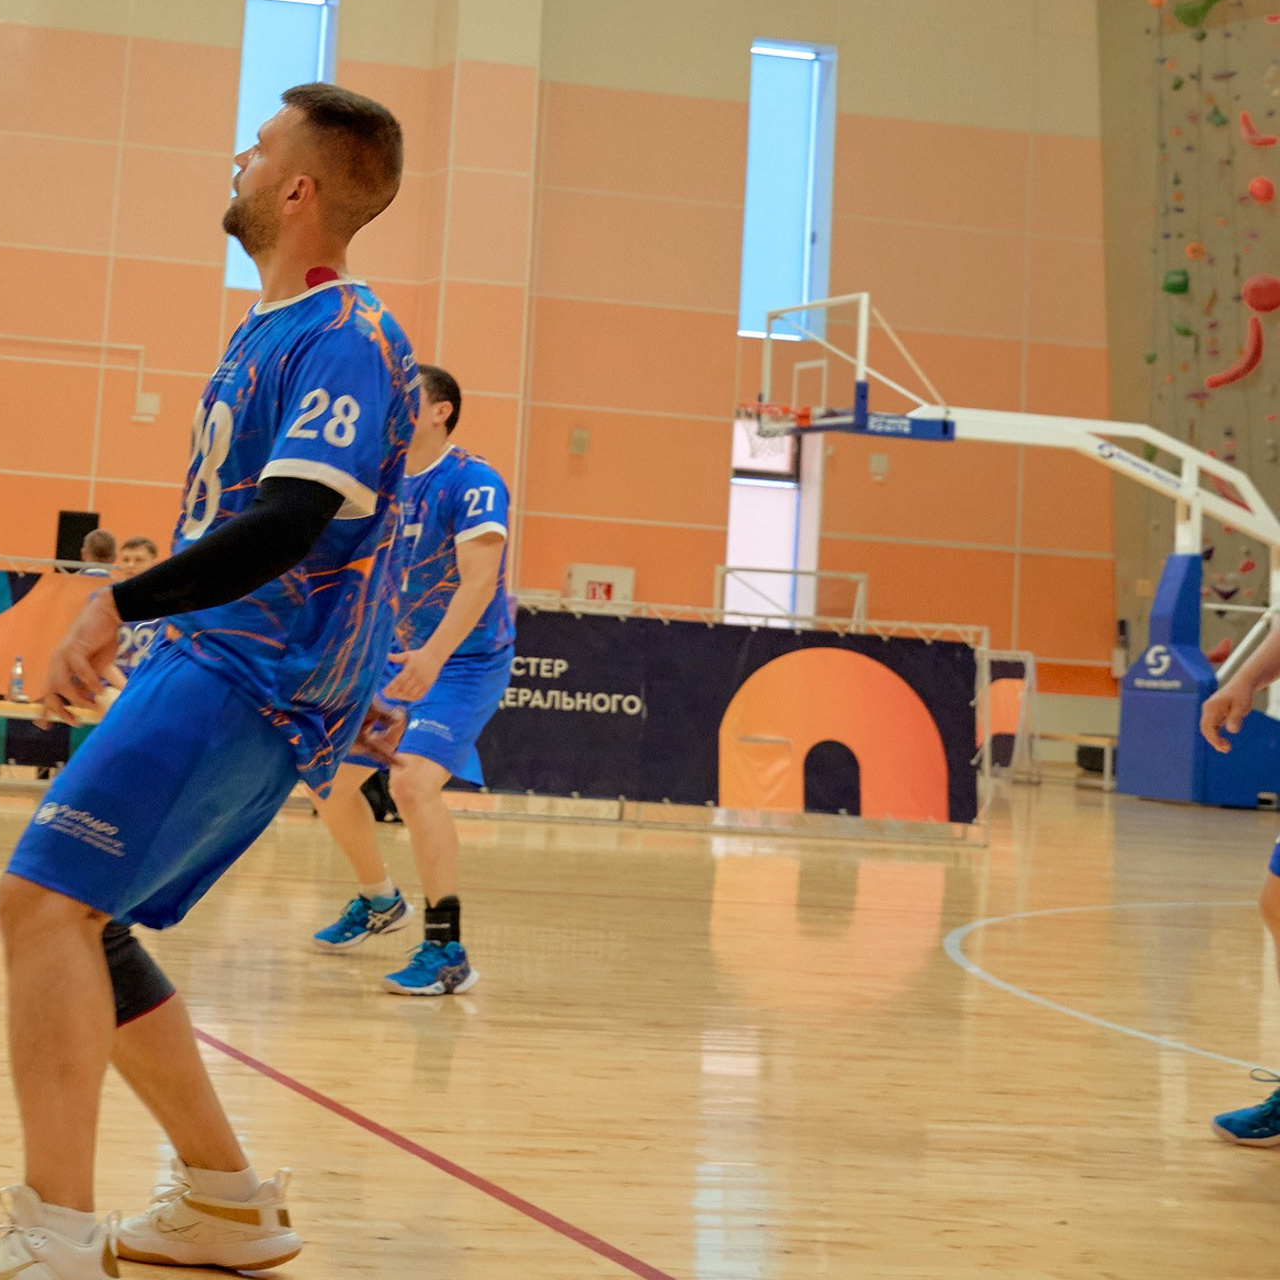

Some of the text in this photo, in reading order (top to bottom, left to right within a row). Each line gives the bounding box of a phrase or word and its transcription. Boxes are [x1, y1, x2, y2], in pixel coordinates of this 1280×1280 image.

[286, 388, 361, 448] 28
[463, 486, 496, 517] 27
[401, 522, 424, 593] 7
[510, 655, 569, 679] СТЕР
[499, 686, 642, 716] ЕРАЛЬНОГО
